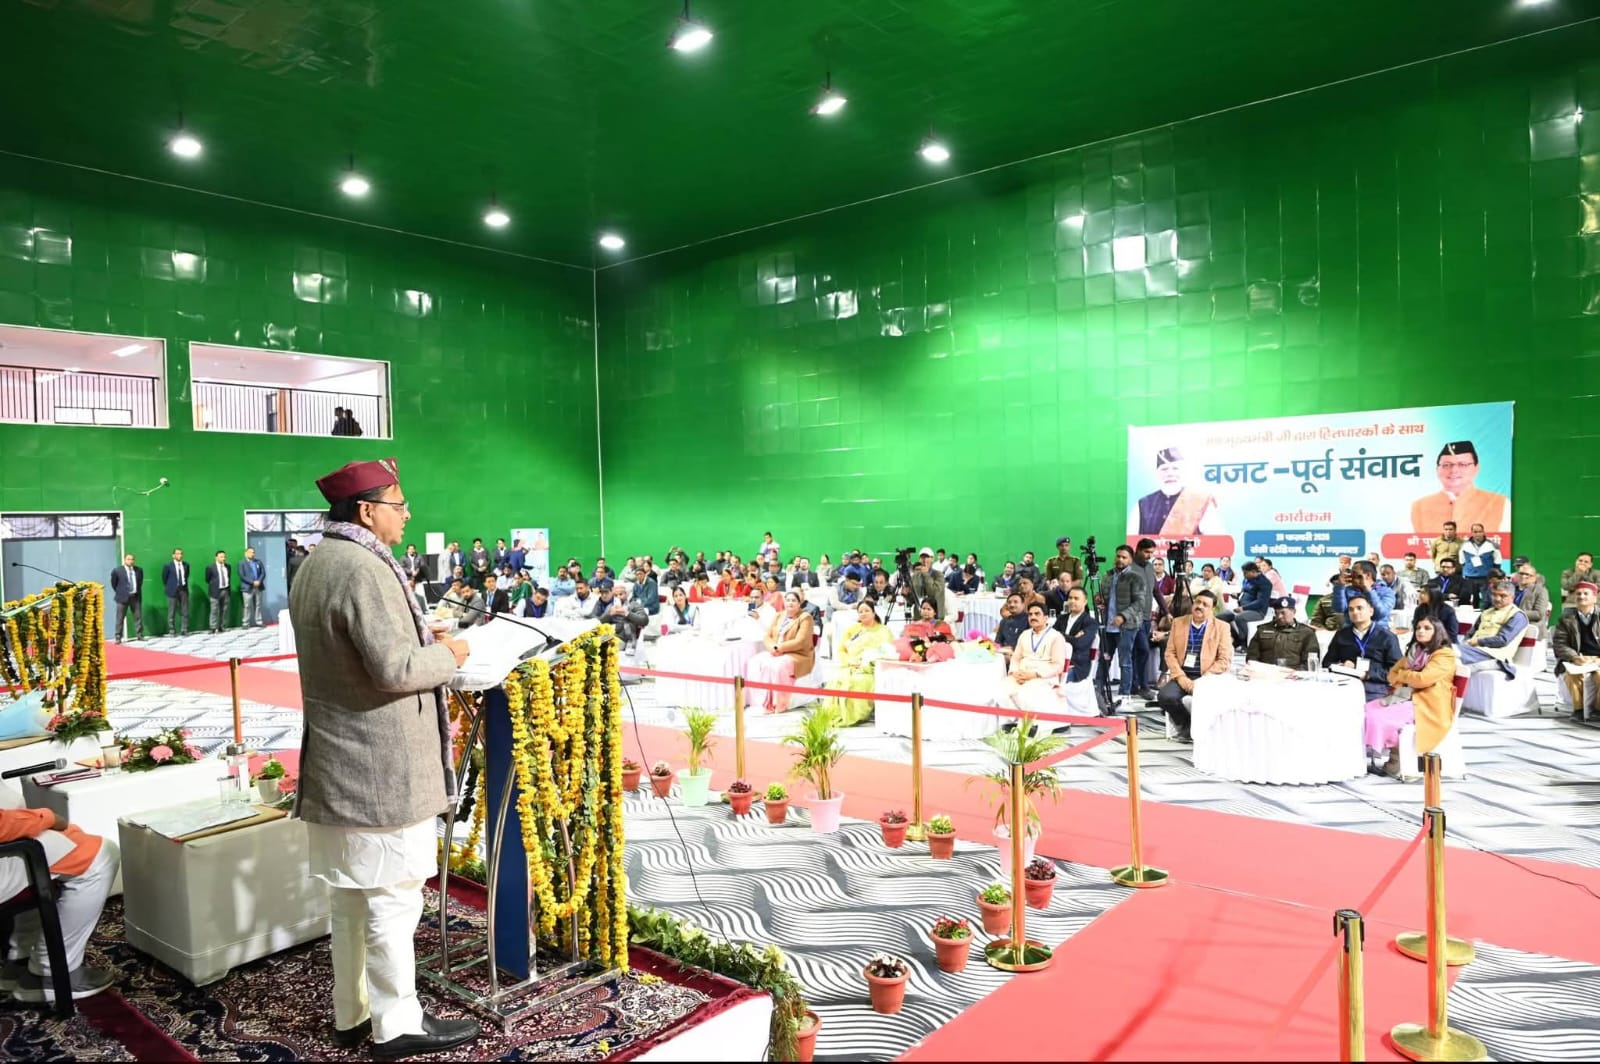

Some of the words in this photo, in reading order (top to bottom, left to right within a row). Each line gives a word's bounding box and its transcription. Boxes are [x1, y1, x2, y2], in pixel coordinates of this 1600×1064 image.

[1382, 422, 1395, 437] के
[1398, 423, 1425, 436] साथ
[1203, 461, 1269, 484] बजट
[1339, 447, 1423, 481] संवाद
[1274, 509, 1332, 523] कार्यक्रम
